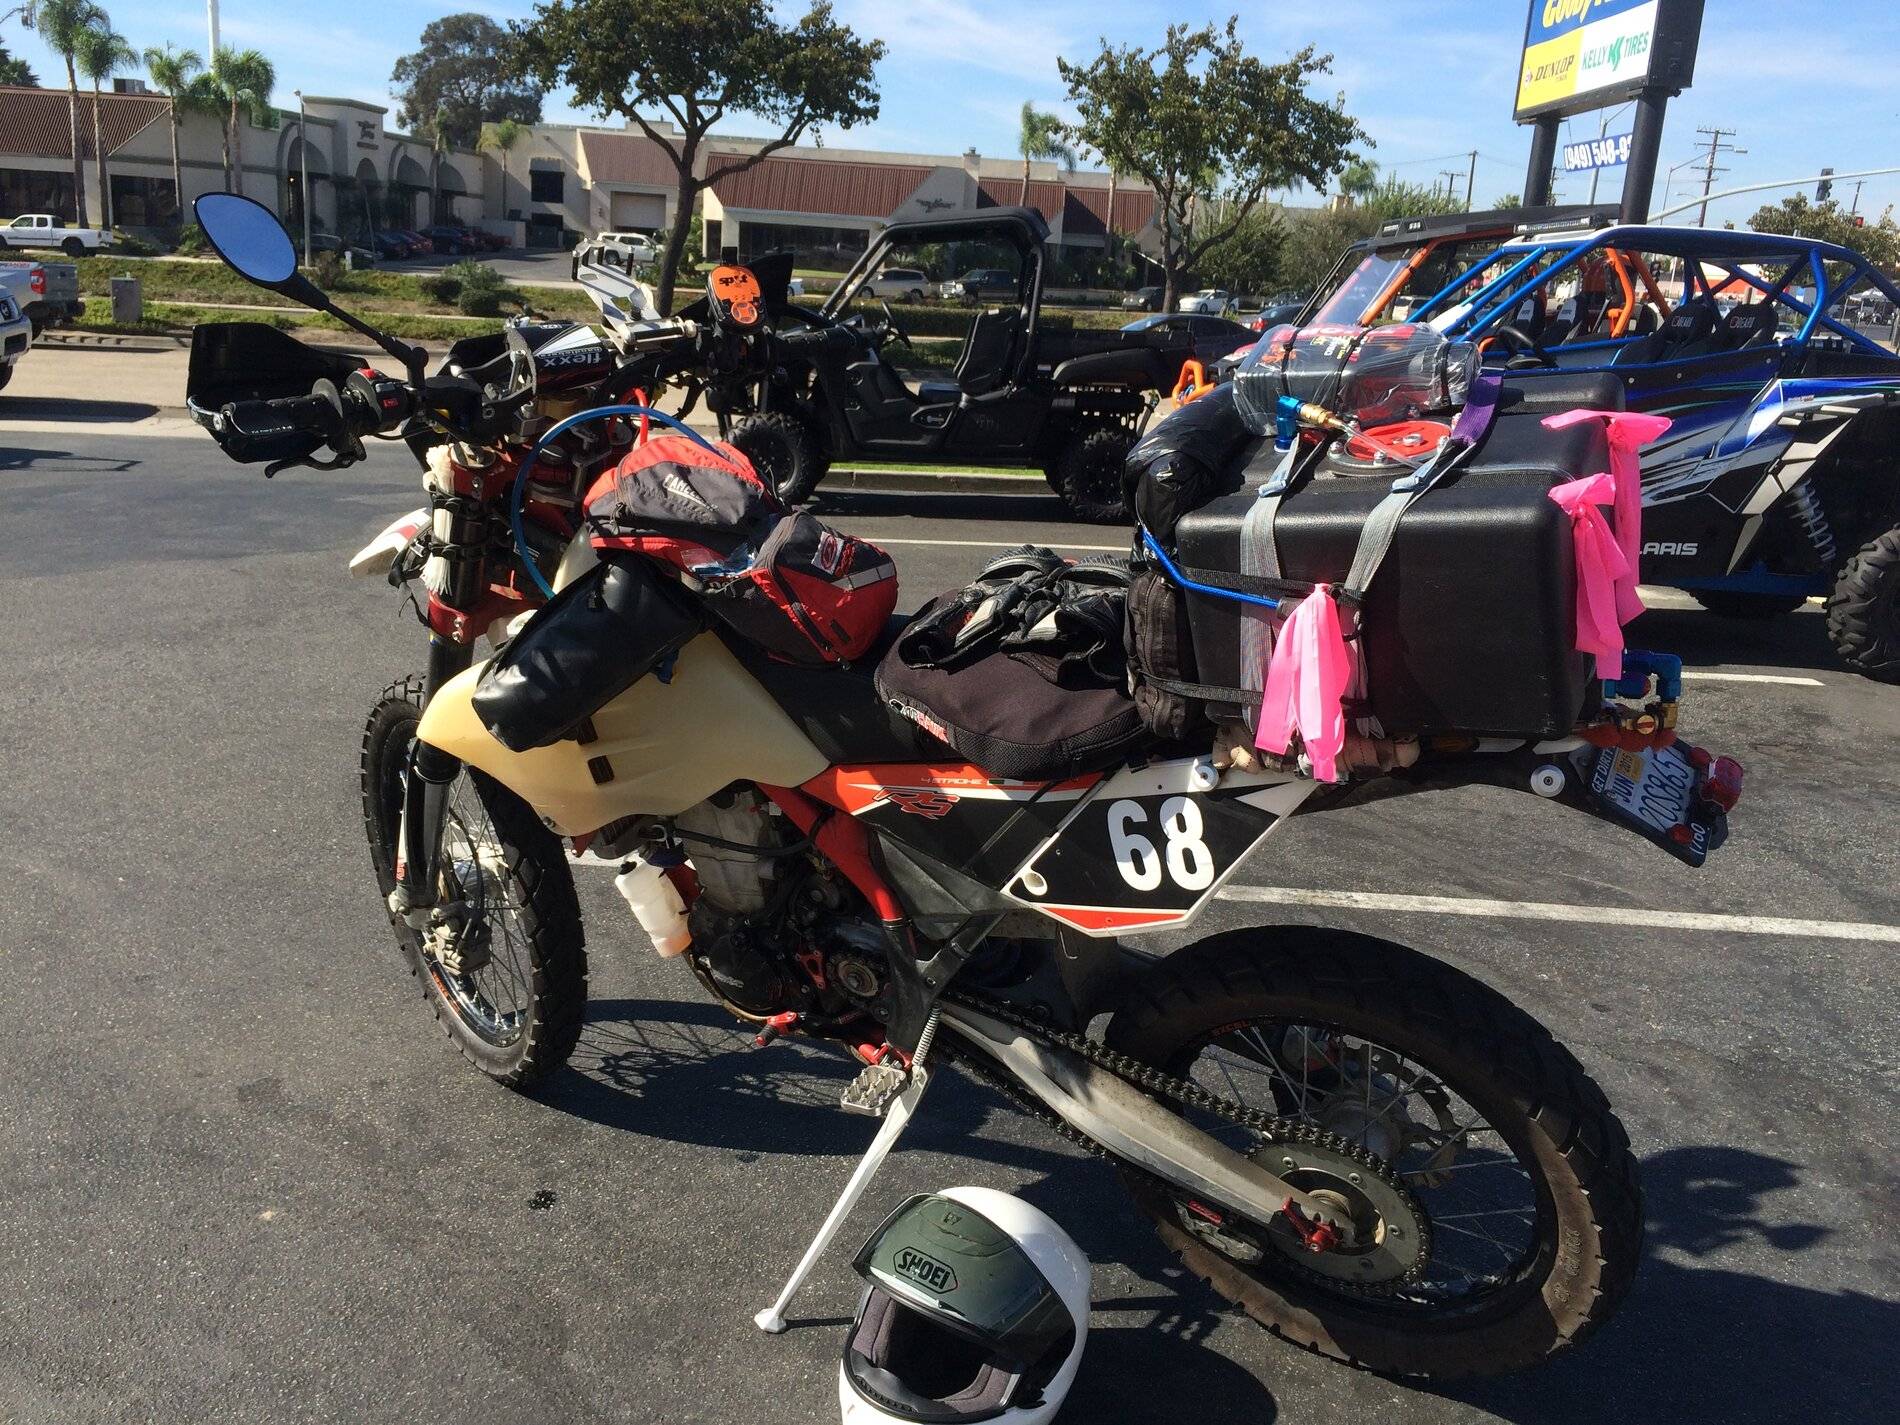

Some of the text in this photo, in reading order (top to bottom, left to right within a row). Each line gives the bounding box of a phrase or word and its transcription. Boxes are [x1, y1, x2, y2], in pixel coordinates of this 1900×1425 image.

[1581, 32, 1650, 71] KELLY TIRES
[1535, 55, 1575, 81] DUNLOP
[1564, 143, 1593, 170] (949)
[1640, 542, 1698, 556] ARIS
[1591, 772, 1606, 793] GET
[1612, 773, 1635, 803] JUN
[1107, 796, 1215, 891] 68
[898, 1251, 951, 1290] SHOEI
